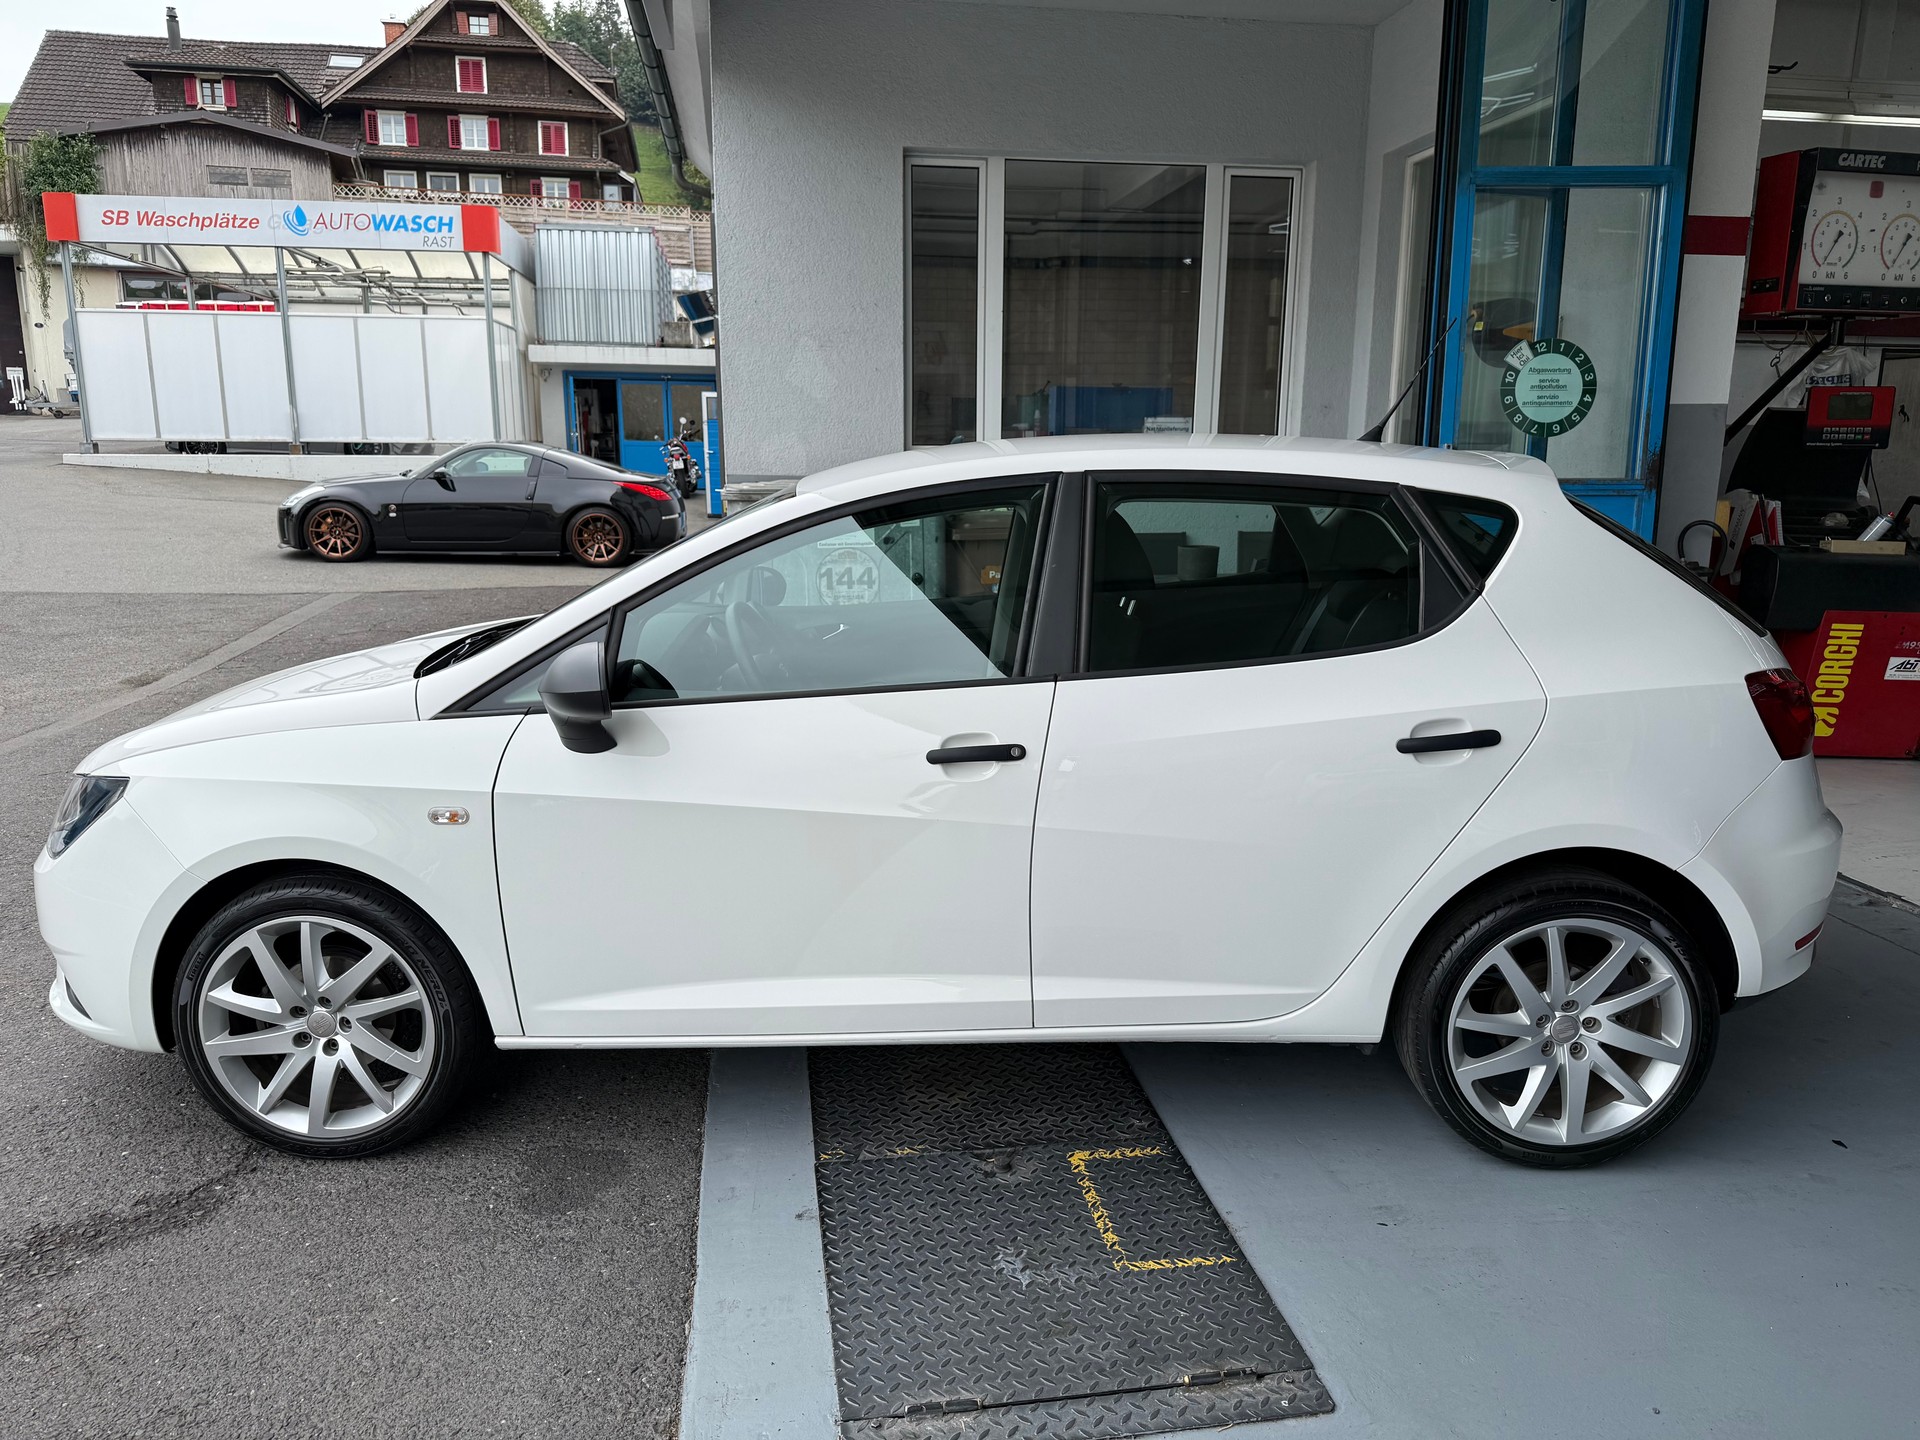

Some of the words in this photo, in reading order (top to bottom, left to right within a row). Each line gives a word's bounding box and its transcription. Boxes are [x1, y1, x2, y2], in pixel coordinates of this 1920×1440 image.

[1838, 153, 1886, 168] CARTEC
[1837, 196, 1842, 205] 3
[1906, 200, 1911, 208] 3
[101, 209, 130, 226] SB
[136, 210, 260, 232] Waschplätze
[312, 212, 454, 234] AUTOWASCH
[423, 236, 455, 248] RAST
[1535, 342, 1547, 352] 12
[1560, 342, 1565, 351] 1
[1510, 346, 1522, 358] Hier
[1575, 354, 1584, 363] 2
[1505, 372, 1516, 383] 10
[1584, 372, 1594, 381] 3
[1504, 396, 1513, 404] 9
[1513, 414, 1522, 423] 8
[1571, 413, 1580, 422] 5
[1530, 425, 1538, 434] 7
[1552, 424, 1560, 433] 6
[819, 566, 876, 590] 144
[1812, 623, 1864, 704] CORGHI
[416, 958, 446, 1002] NERO
